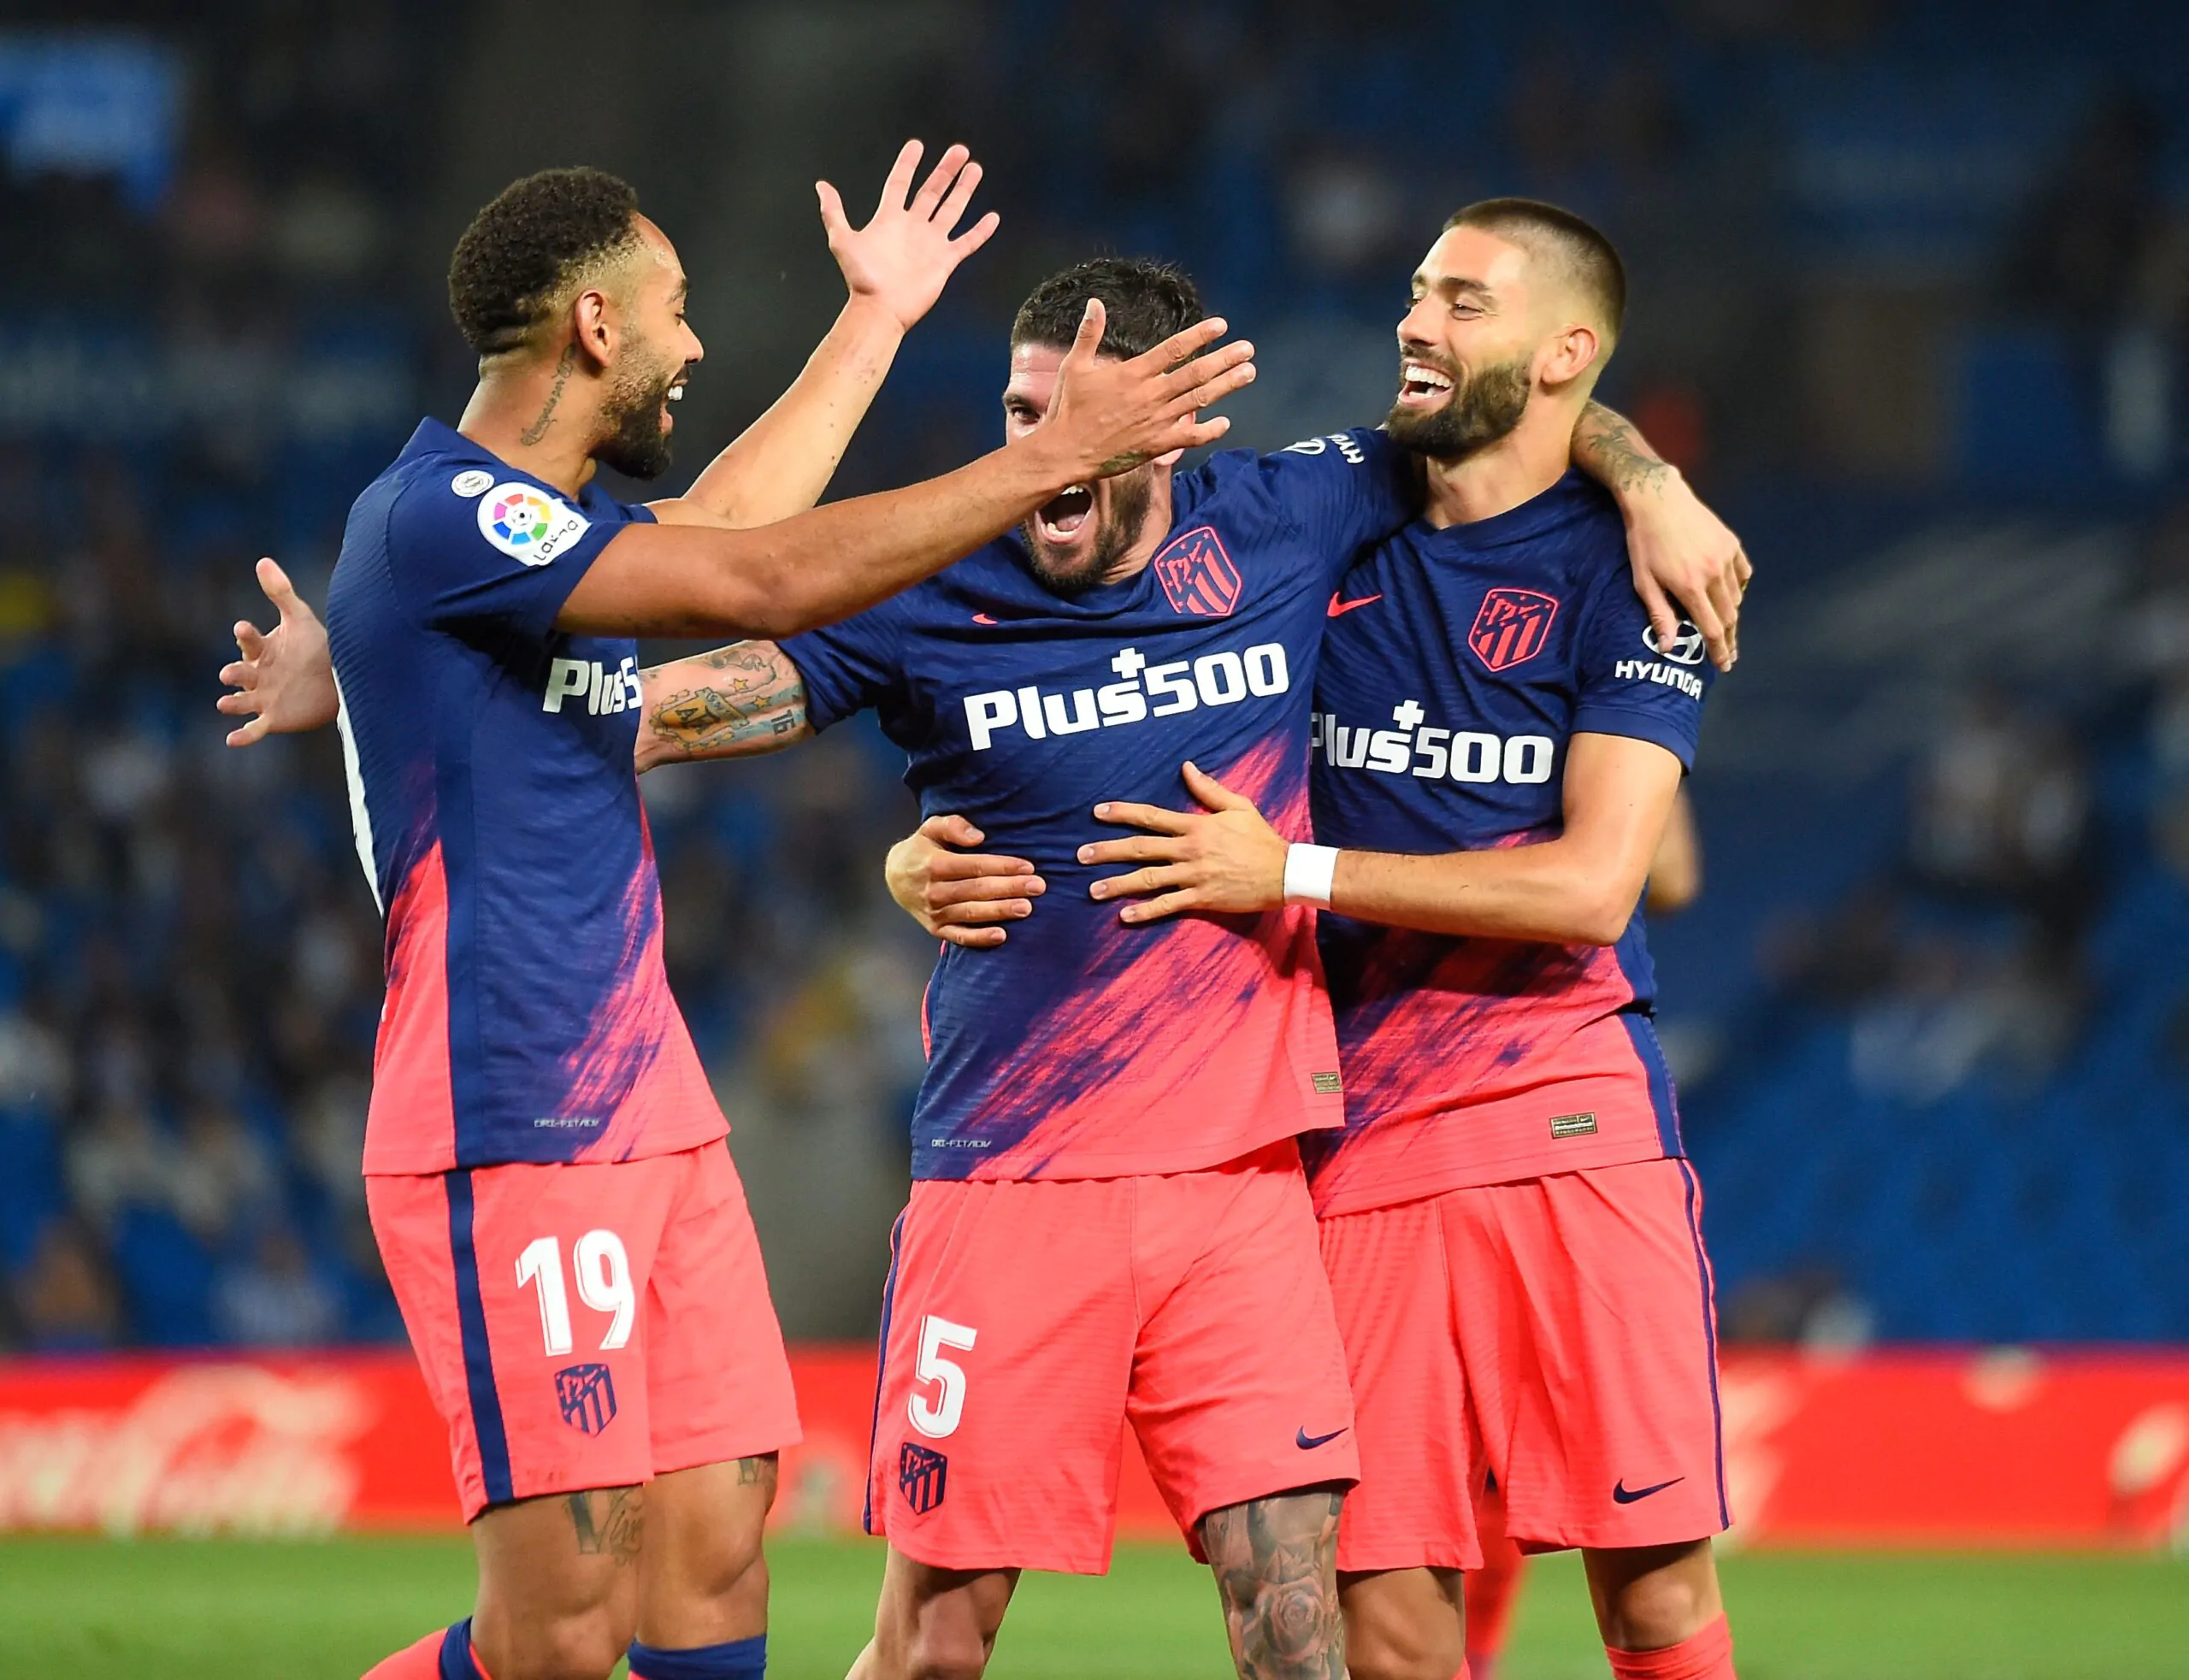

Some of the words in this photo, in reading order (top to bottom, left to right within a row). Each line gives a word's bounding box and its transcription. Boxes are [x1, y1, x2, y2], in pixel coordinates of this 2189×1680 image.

[963, 643, 1289, 751] Plus500
[1614, 659, 1702, 702] HYUNDA
[515, 1229, 635, 1357] 19
[907, 1314, 977, 1438] 5
